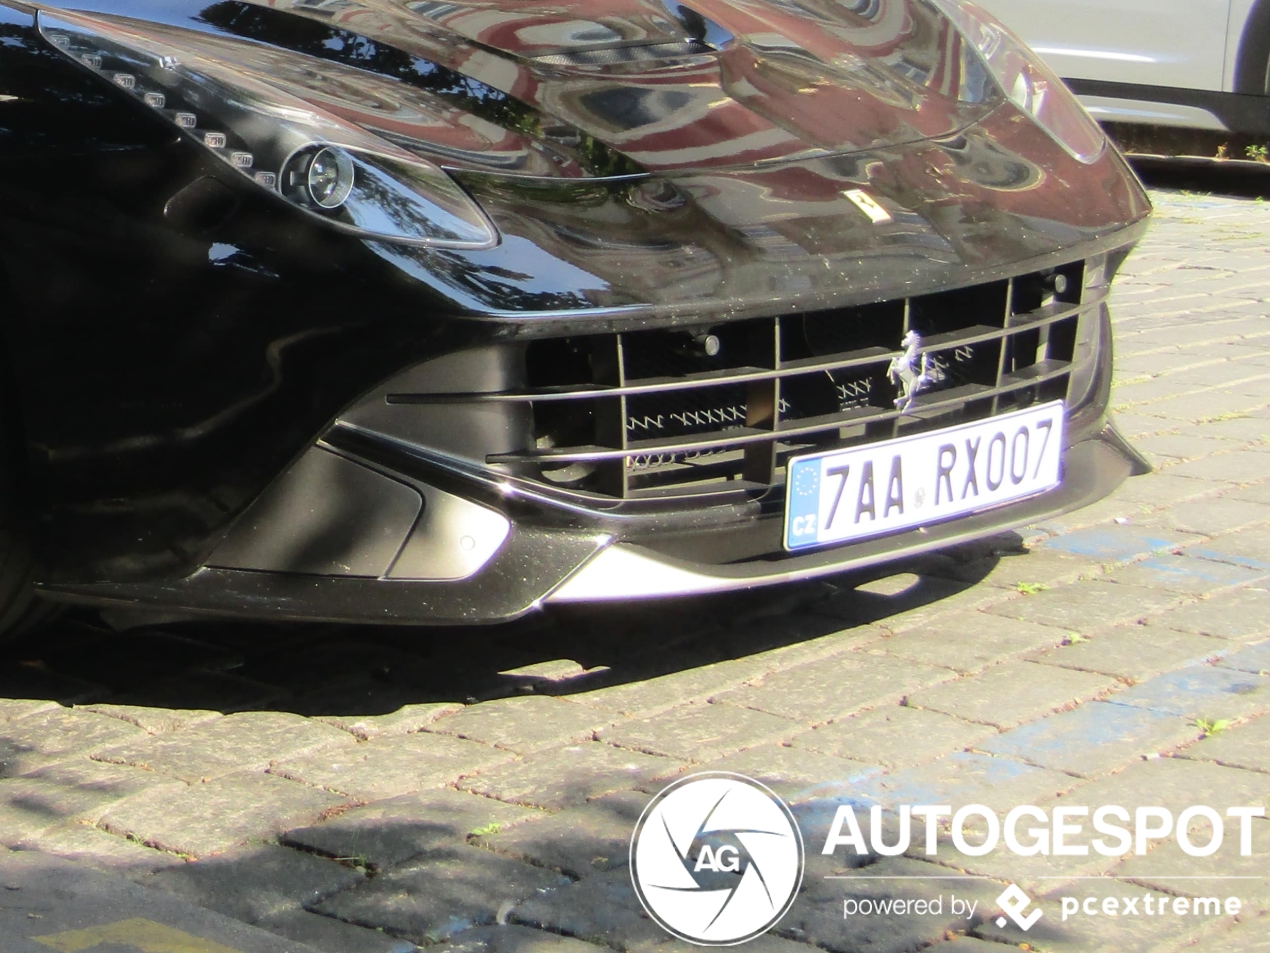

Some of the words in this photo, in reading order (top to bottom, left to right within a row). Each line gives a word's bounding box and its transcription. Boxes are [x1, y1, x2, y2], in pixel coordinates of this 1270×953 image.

[792, 513, 816, 537] CZ
[823, 454, 905, 530] 7AA
[933, 419, 1054, 507] RX007
